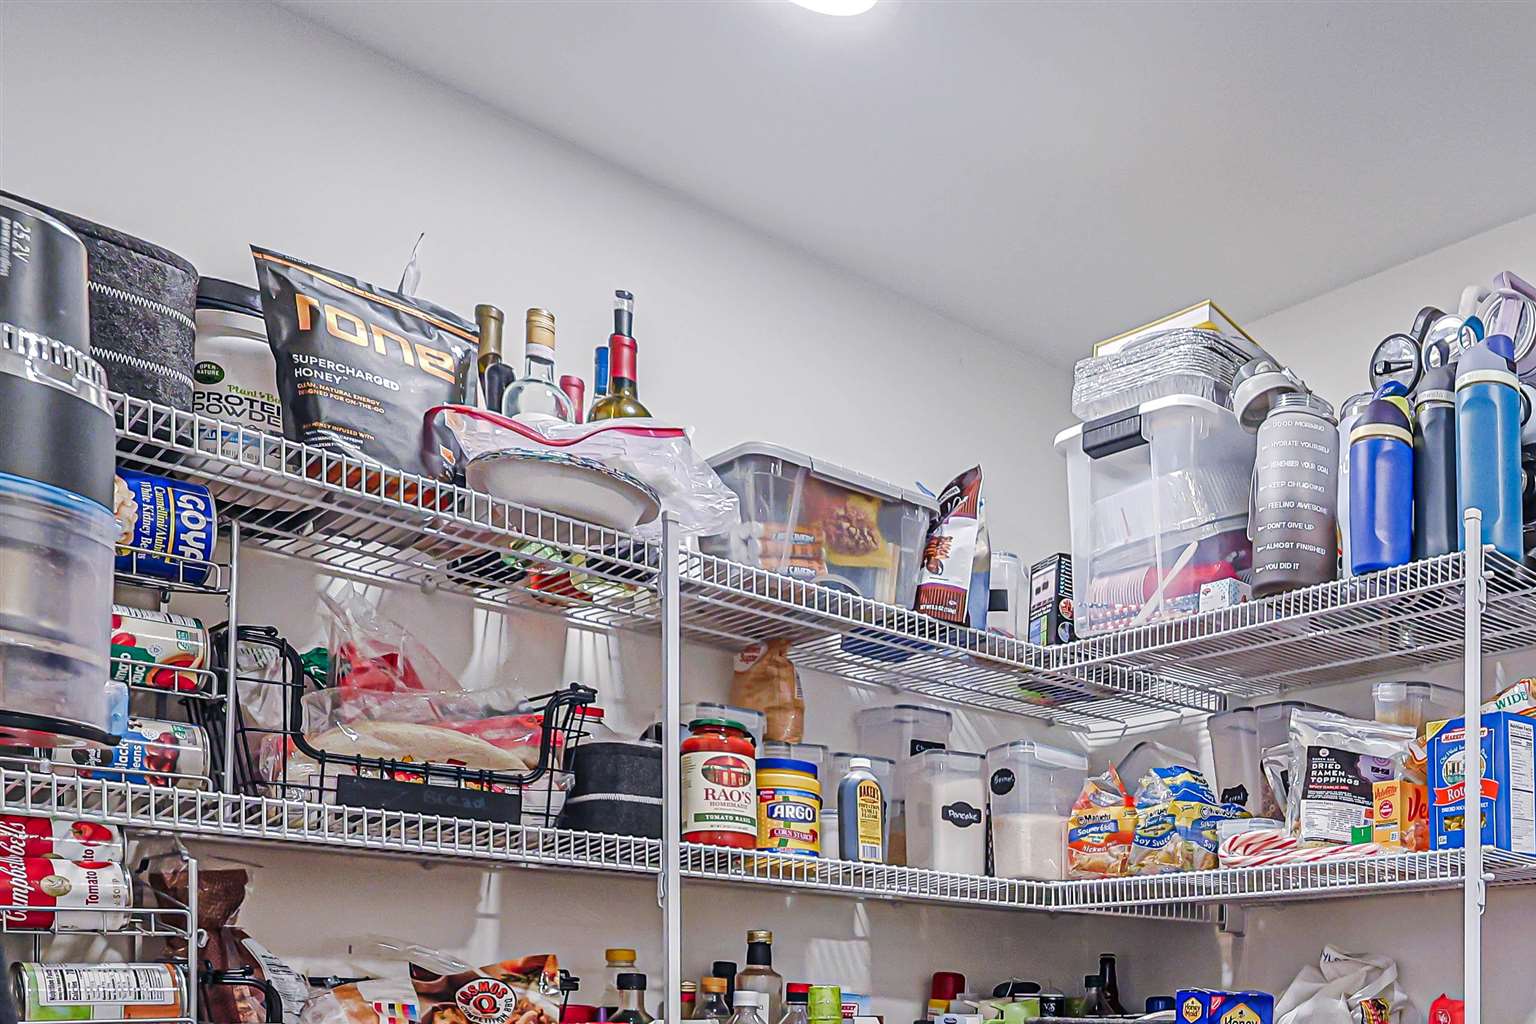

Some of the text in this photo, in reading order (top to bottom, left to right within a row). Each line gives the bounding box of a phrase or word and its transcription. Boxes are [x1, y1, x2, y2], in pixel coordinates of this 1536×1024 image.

[12, 220, 32, 263] 25.2V
[292, 354, 400, 392] SUPERCHARGED
[294, 368, 346, 385] HONEY
[227, 385, 257, 397] Plant
[319, 384, 352, 399] NATURAL
[192, 391, 281, 416] PROTEI
[329, 392, 345, 402] FOR
[345, 398, 385, 414] ON-THE-GO
[192, 403, 281, 427] POWDE
[1294, 422, 1325, 432] MORNING
[1300, 442, 1330, 453] YOURSELF
[140, 481, 152, 502] White
[1268, 501, 1328, 514] FEELING AWESOME
[139, 504, 154, 536] Kidney
[177, 494, 207, 561] GOYA
[1267, 522, 1286, 530] DON'T
[1296, 542, 1326, 555] FINISHED
[1495, 689, 1529, 711] WIDE
[114, 741, 129, 771] lack
[132, 745, 142, 771] eans
[1310, 777, 1360, 786] TOPPINGS
[703, 788, 751, 804] RAO'S
[735, 815, 752, 823] BASIL
[772, 807, 814, 821] ARGO
[948, 810, 978, 820] Pancake
[774, 829, 814, 841] CORN STARCH
[1134, 836, 1150, 847] Soy
[1083, 842, 1107, 852] hicken
[1203, 840, 1217, 851] Soy
[86, 871, 99, 905] Tomato
[458, 981, 508, 1005] KOSMOS
[472, 994, 500, 1014] Q
[1185, 1003, 1200, 1012] Honey
